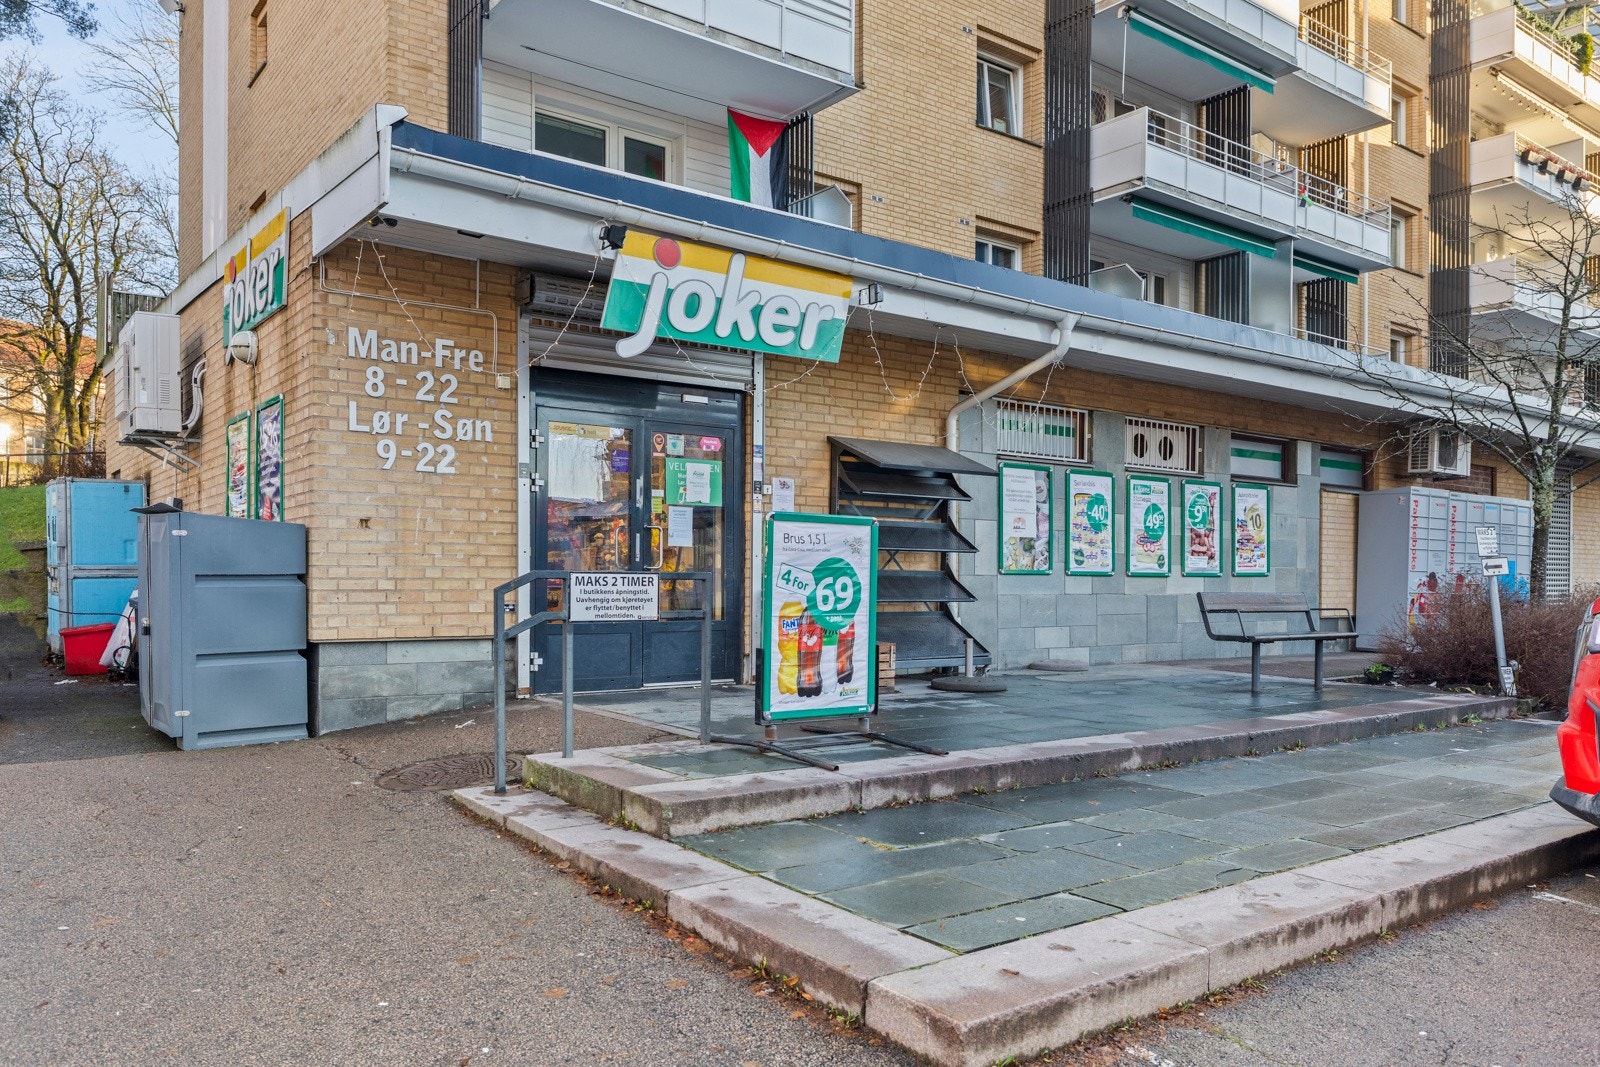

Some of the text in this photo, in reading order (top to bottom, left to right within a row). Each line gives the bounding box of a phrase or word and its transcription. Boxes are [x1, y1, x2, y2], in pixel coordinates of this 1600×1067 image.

[224, 238, 280, 366] joker
[615, 237, 836, 358] joker
[668, 461, 720, 473] VELEN
[1194, 505, 1203, 522] 9
[1249, 513, 1262, 531] 10
[783, 533, 806, 545] Brus
[808, 534, 821, 546] 1,5
[1411, 499, 1419, 570] Pakkeboks
[1449, 505, 1457, 573] Pakkeboks
[574, 576, 655, 587] MAKS 2 TIMER
[781, 569, 809, 591] 4 for
[615, 588, 650, 597] åpningstid.
[816, 576, 854, 612] 69
[782, 618, 800, 629] FANT
